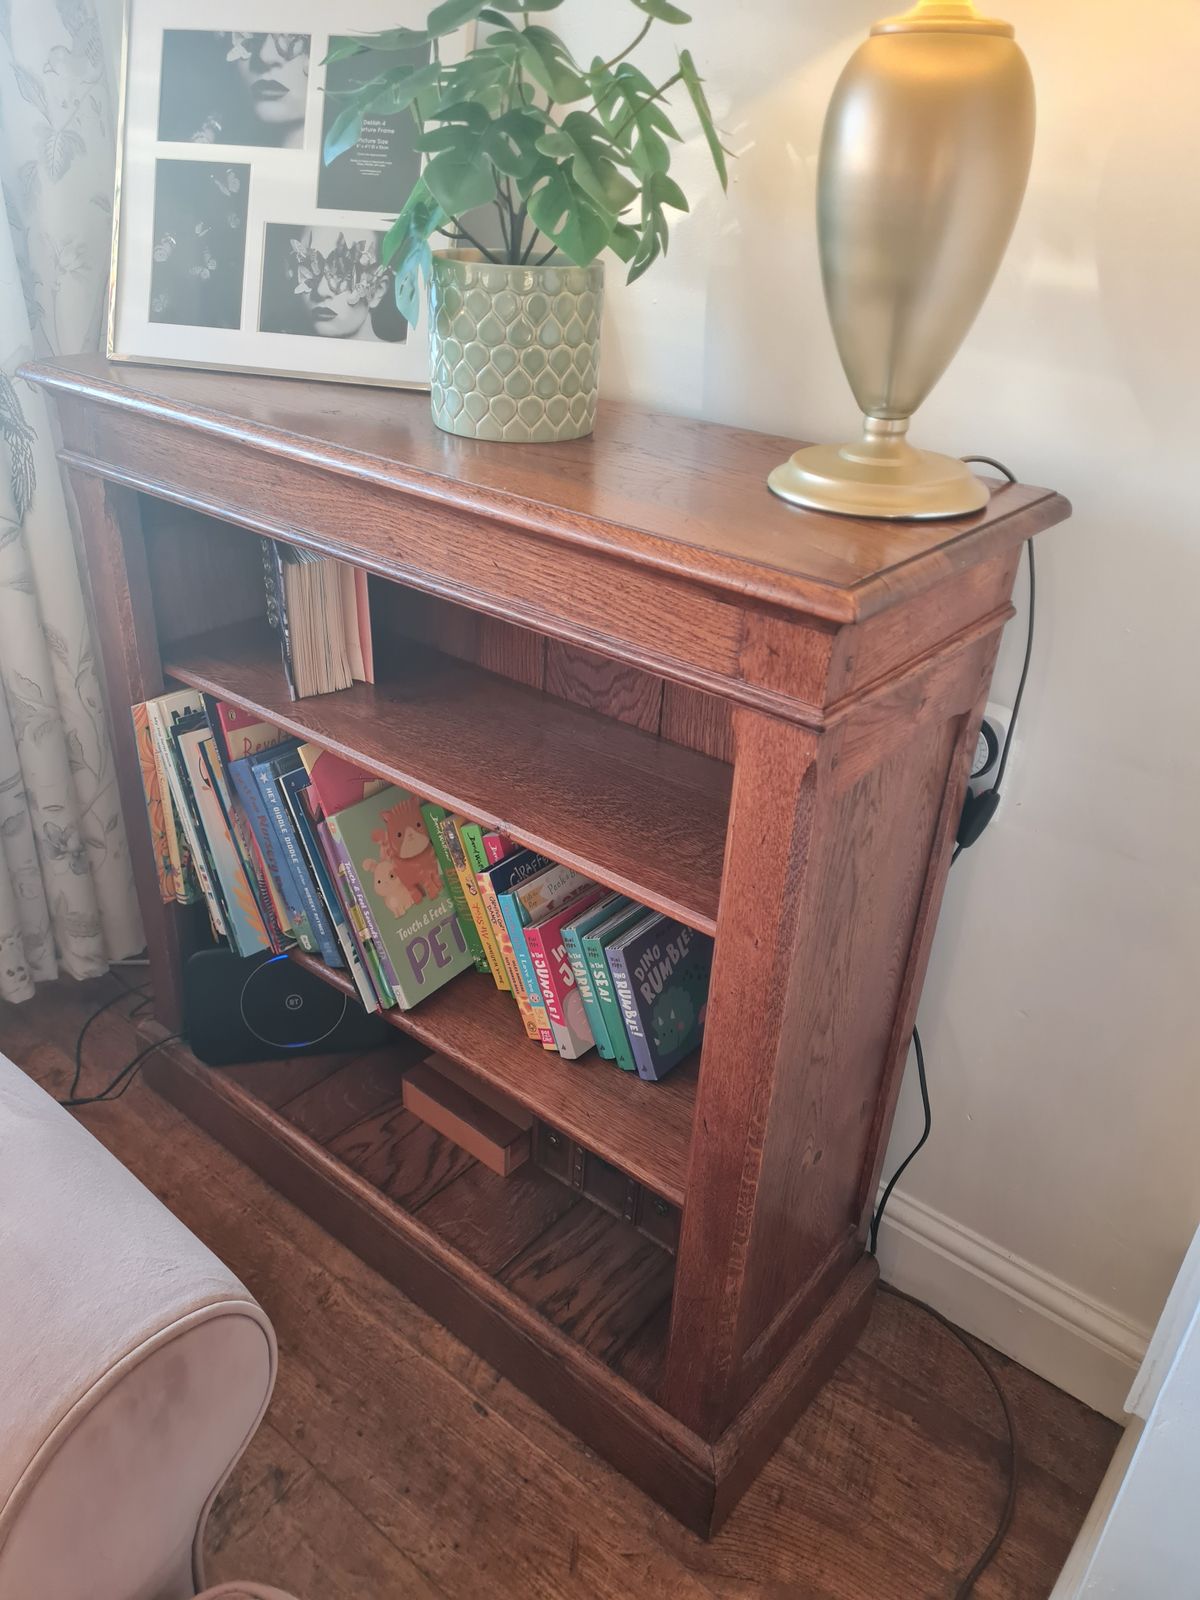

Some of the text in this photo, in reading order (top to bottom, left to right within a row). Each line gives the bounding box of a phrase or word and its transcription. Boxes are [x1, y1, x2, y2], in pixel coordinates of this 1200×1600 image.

[266, 787, 277, 804] HEY
[273, 806, 288, 833] DIDDLE
[284, 836, 299, 864] DIDDLE
[344, 862, 355, 884] Touch
[354, 885, 360, 893] &
[357, 894, 367, 909] Feel
[364, 909, 379, 939] Sounds
[396, 918, 423, 940] Touch
[423, 913, 430, 925] &
[429, 902, 448, 919] Feel
[406, 912, 467, 985] PET
[634, 944, 661, 982] DINO
[534, 960, 560, 1020] JUNGLE!
[571, 961, 594, 1003] FARM!
[594, 971, 612, 1003] SEA!
[616, 981, 643, 1038] RUMBLE!
